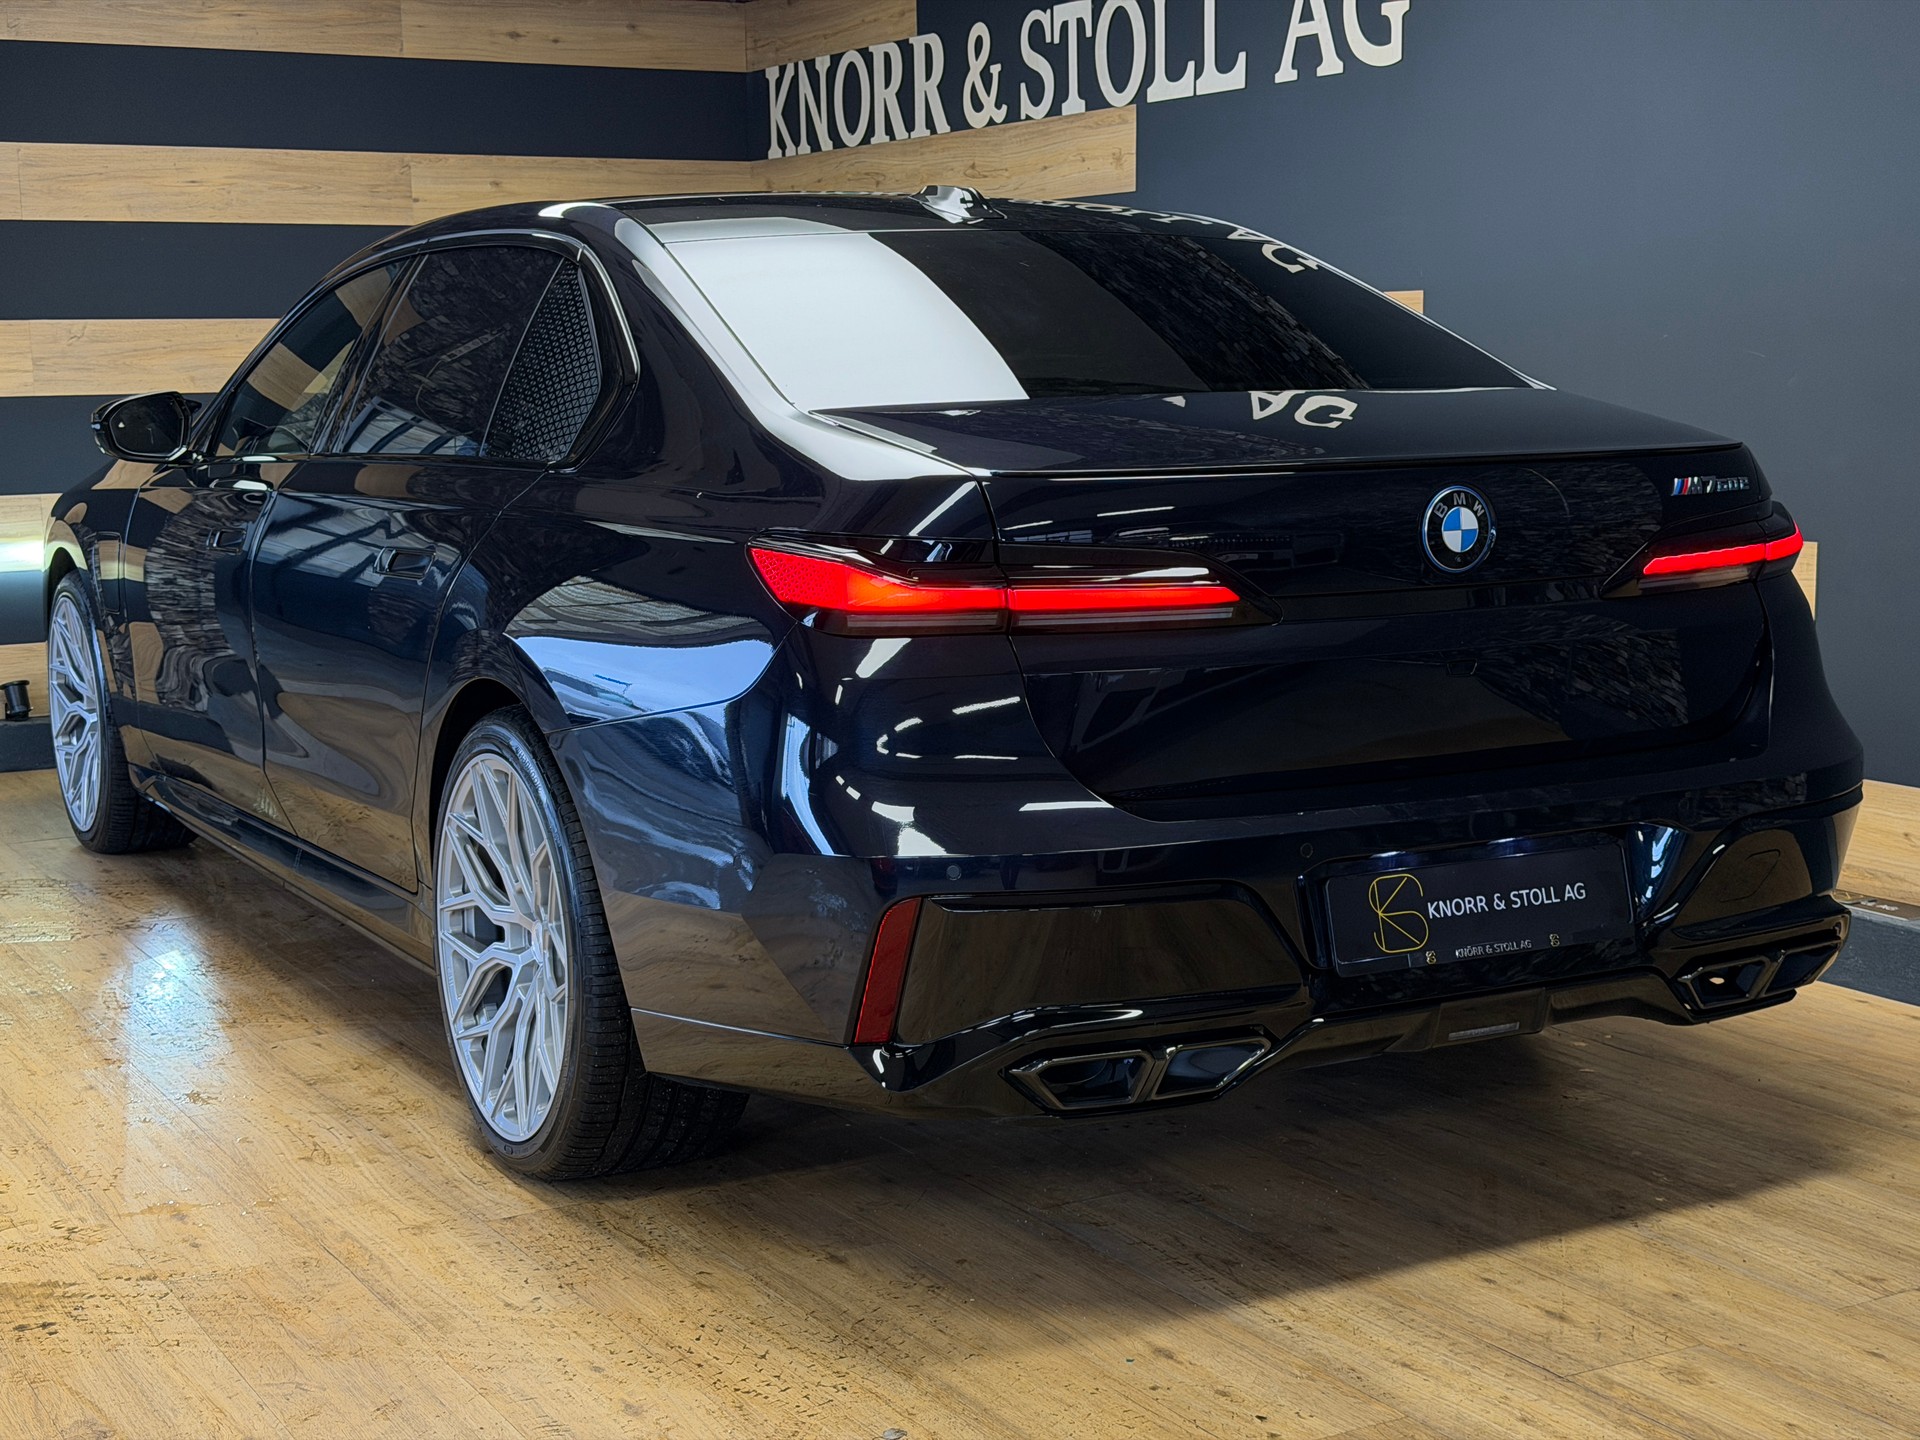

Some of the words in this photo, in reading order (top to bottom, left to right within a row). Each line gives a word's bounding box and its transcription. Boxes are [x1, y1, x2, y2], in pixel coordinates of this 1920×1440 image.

[764, 32, 951, 160] KNORR
[963, 21, 1008, 129] &
[1019, 0, 1247, 120] STOLL
[1433, 492, 1486, 519] BMW
[1427, 895, 1489, 919] KNORR
[1493, 893, 1506, 910] &
[1509, 886, 1561, 909] STOLL
[1564, 882, 1586, 901] AG
